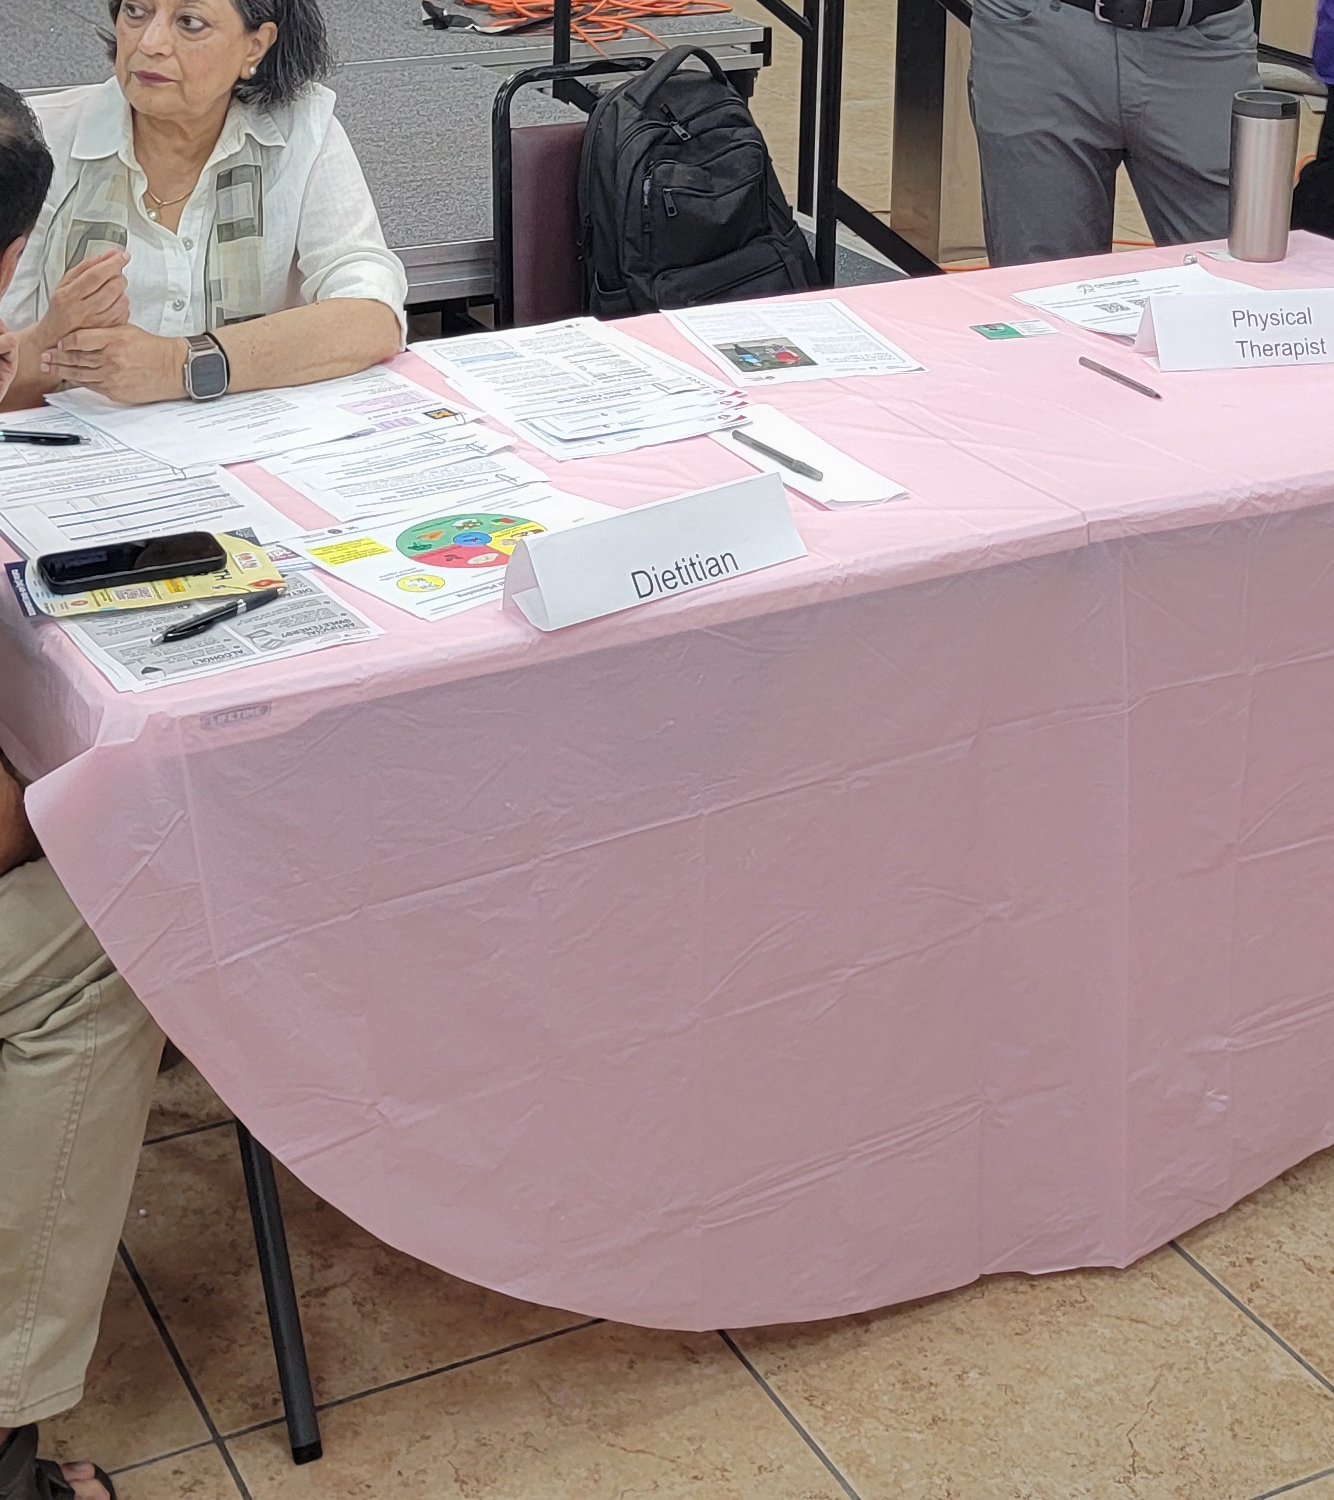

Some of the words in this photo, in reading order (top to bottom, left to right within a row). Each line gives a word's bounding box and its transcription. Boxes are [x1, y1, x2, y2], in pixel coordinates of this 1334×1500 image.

[1232, 306, 1313, 332] Physical
[1234, 337, 1328, 361] Therapist
[630, 552, 740, 600] Dietitian
